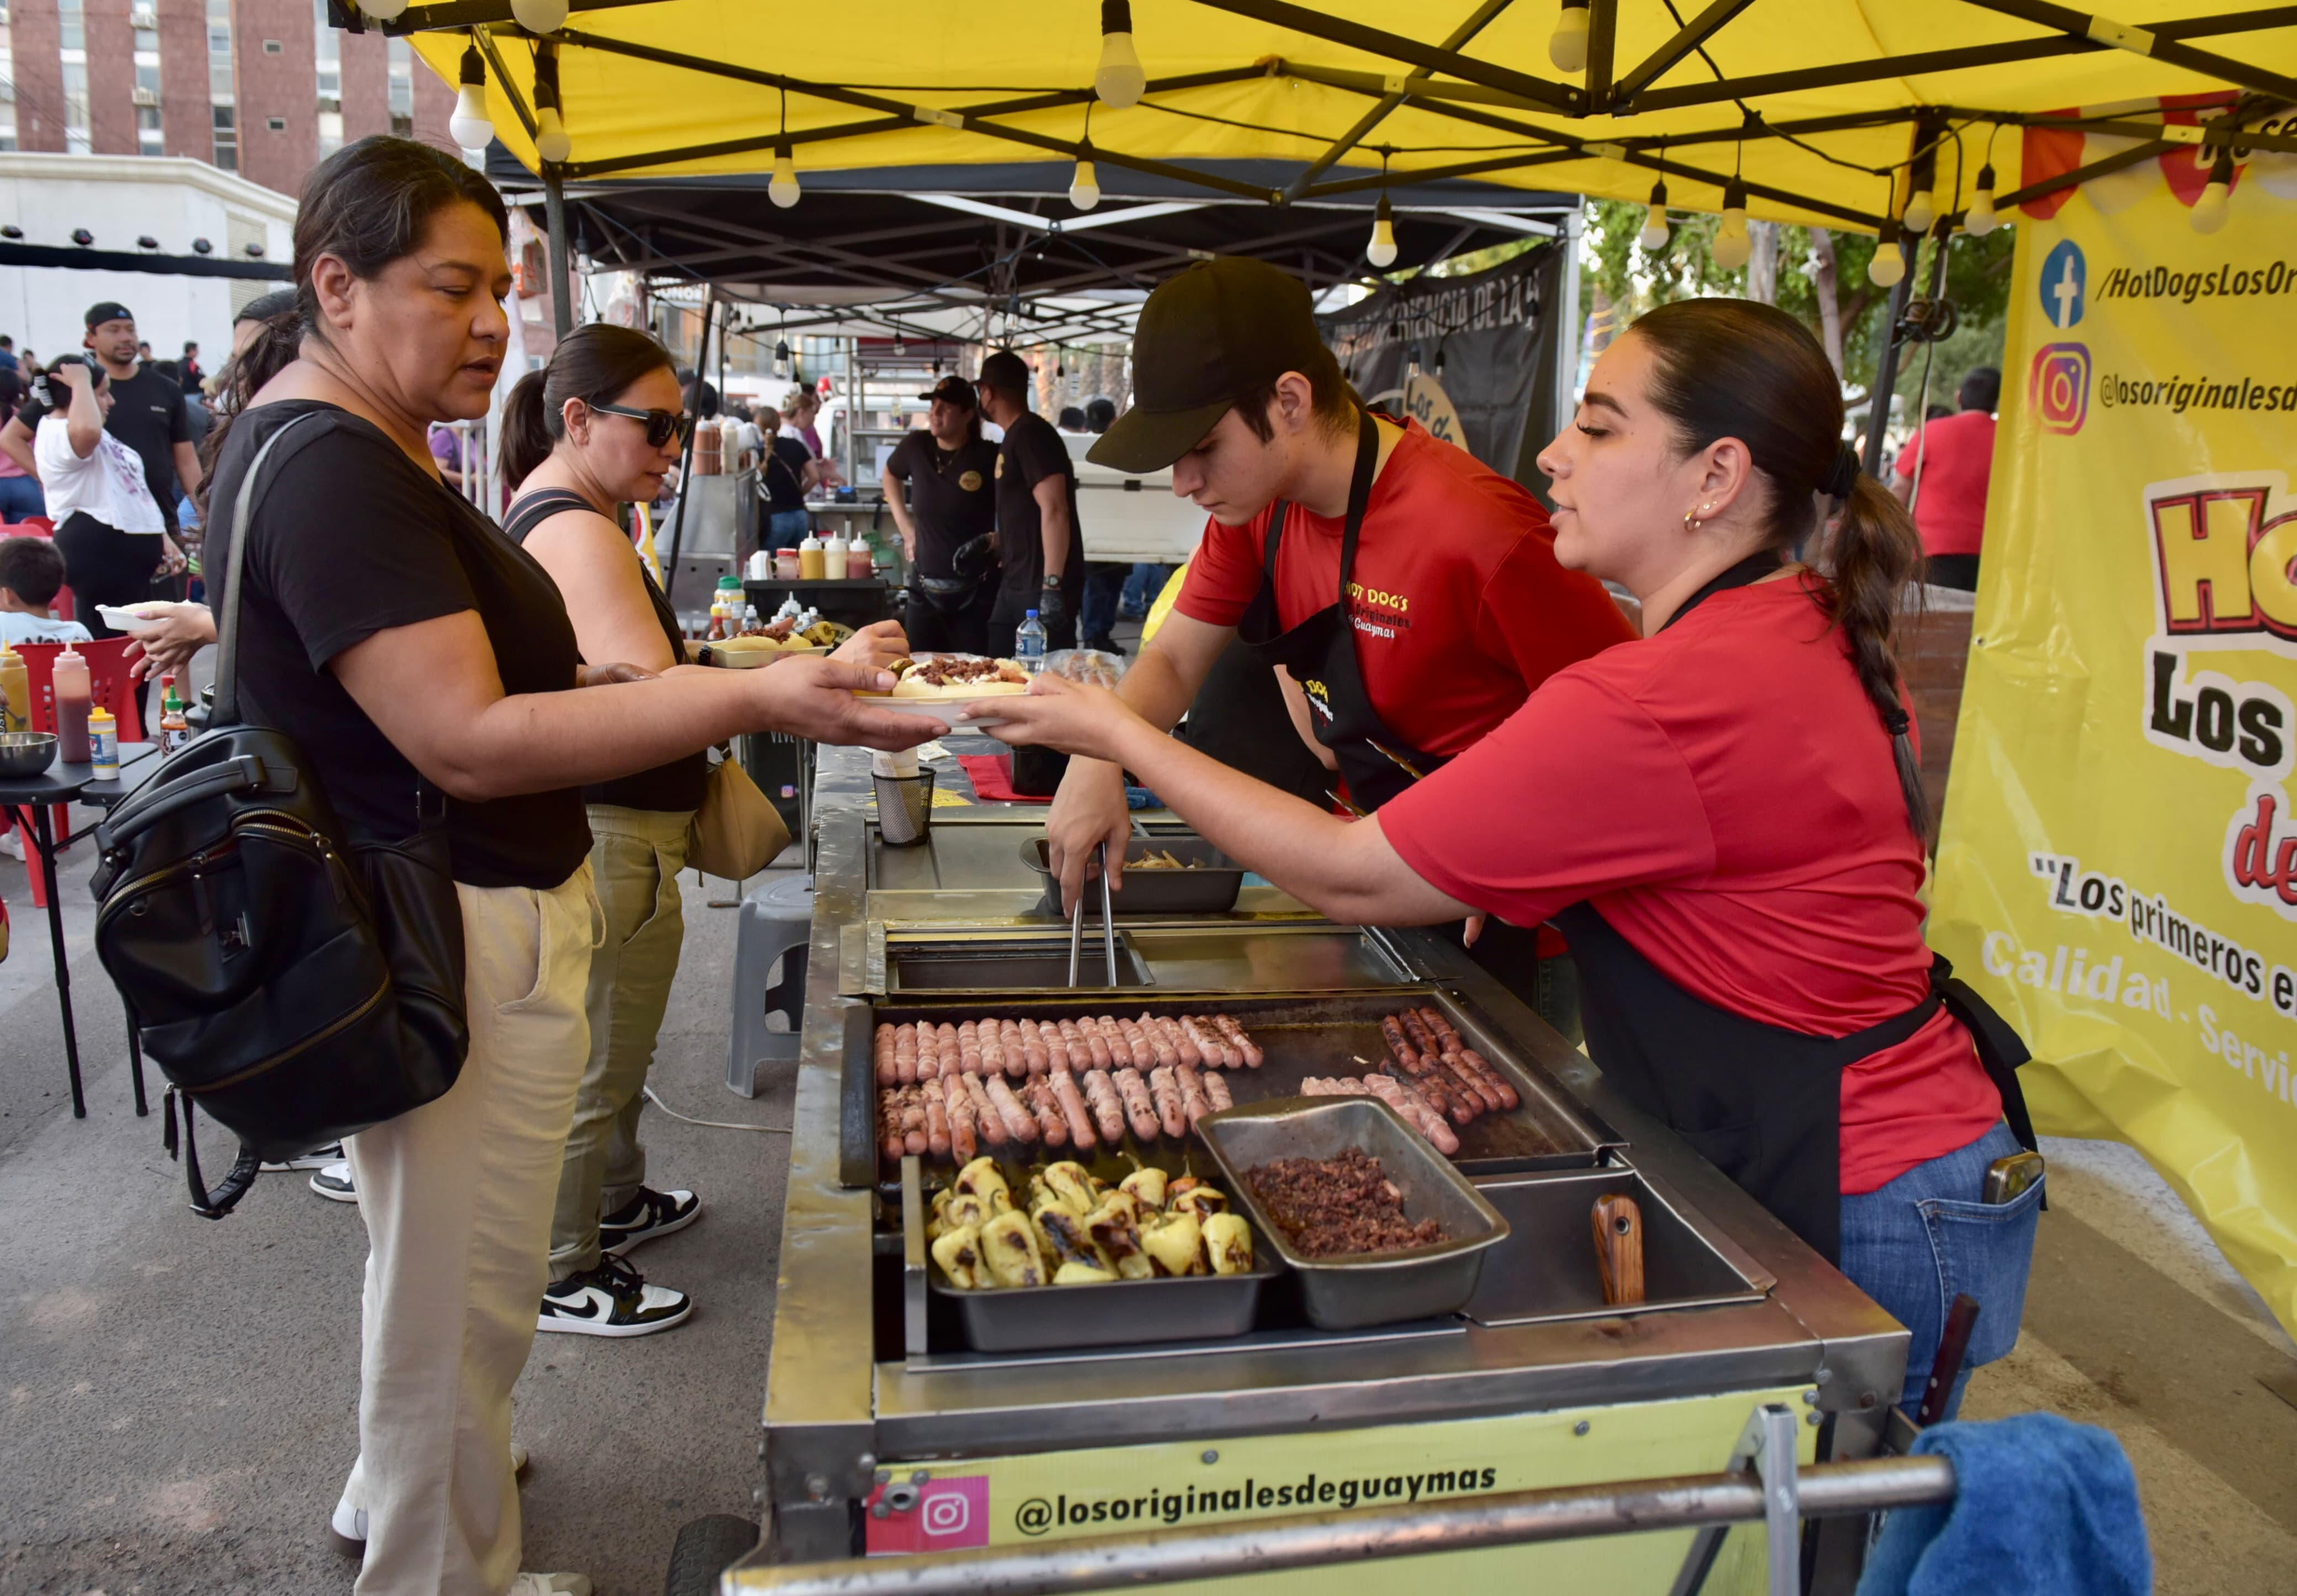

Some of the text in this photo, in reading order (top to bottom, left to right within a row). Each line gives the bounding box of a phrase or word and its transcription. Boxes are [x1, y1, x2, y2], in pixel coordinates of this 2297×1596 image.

[1354, 617, 1395, 639] Guaymas
[1982, 930, 2172, 1022] Calidad
[2131, 895, 2261, 994] primeros
[2274, 972, 2297, 1016] e
[1015, 1467, 1496, 1536] @losoriginalesdeguaymas
